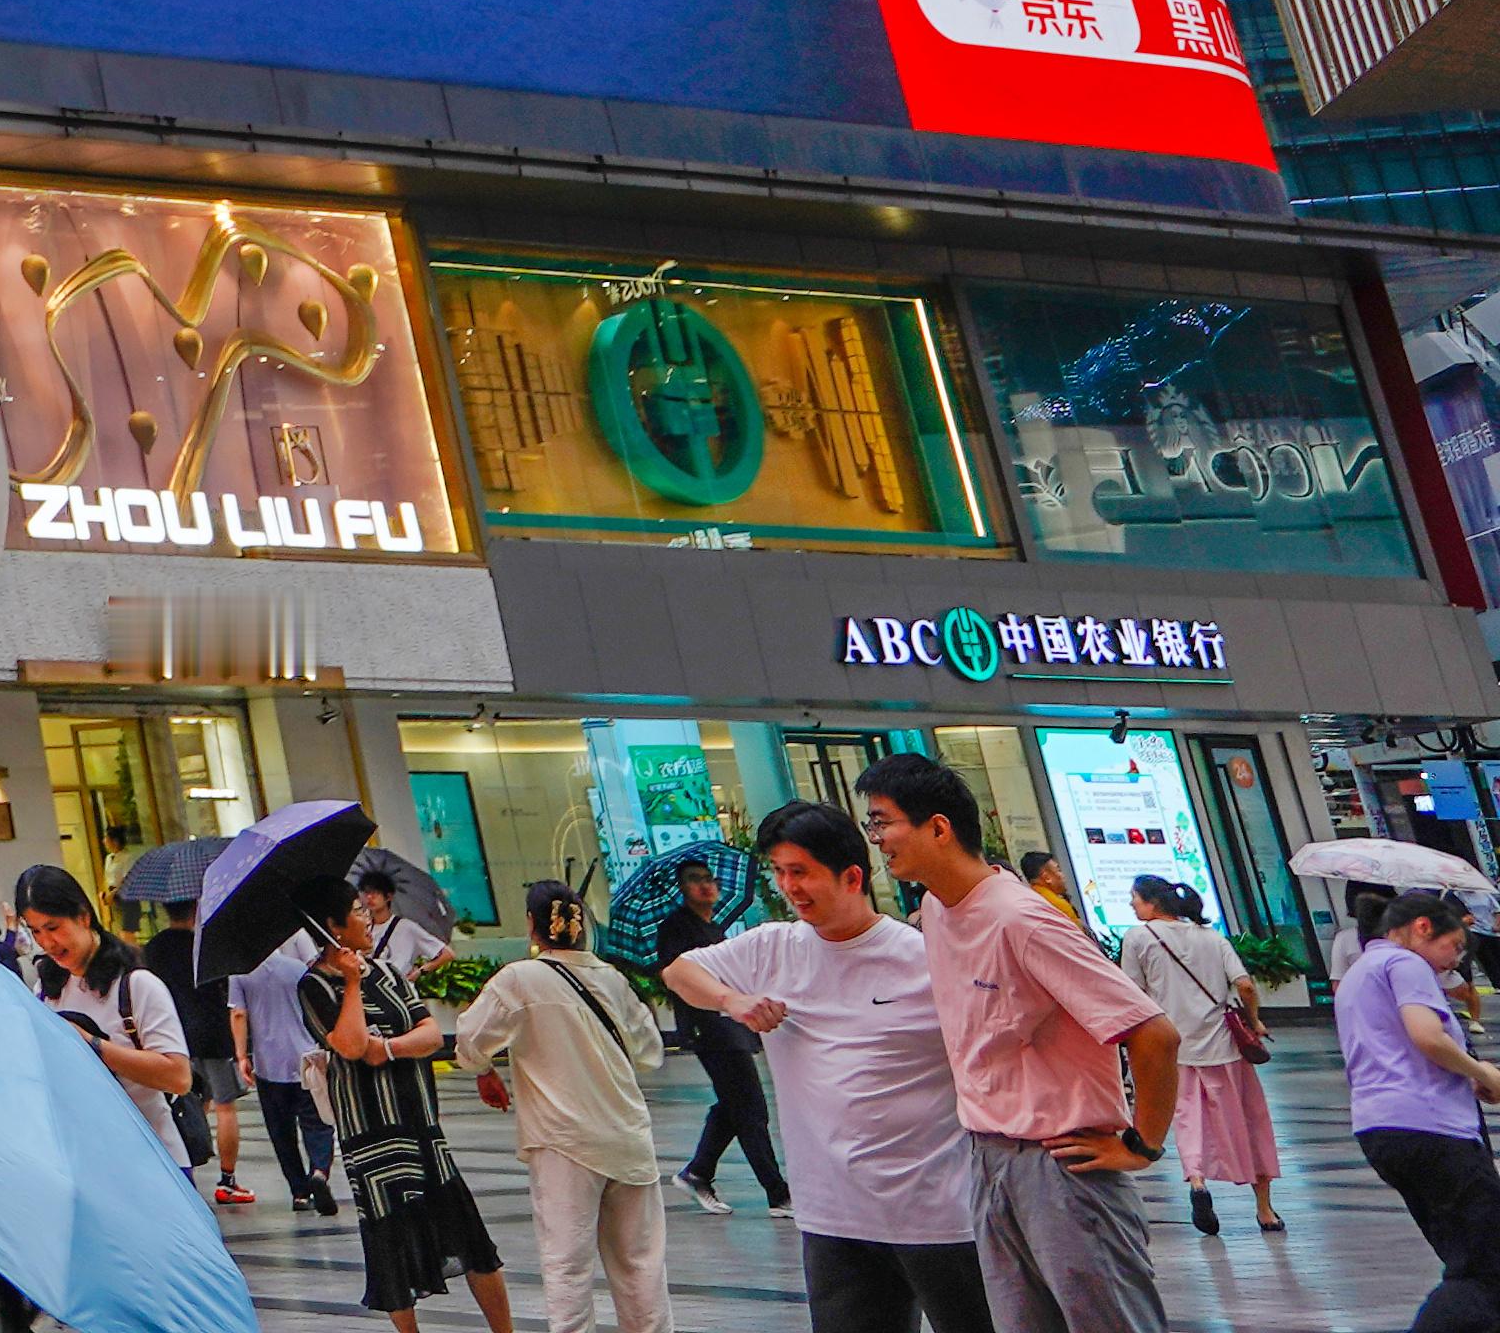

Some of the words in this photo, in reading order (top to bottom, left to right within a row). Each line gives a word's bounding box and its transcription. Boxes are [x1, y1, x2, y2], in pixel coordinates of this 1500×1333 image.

[22, 484, 215, 547] ZHOU
[226, 490, 329, 550] LIU
[336, 498, 424, 553] FU
[842, 615, 940, 667] ABC
[998, 609, 1227, 671] 中国农业银行
